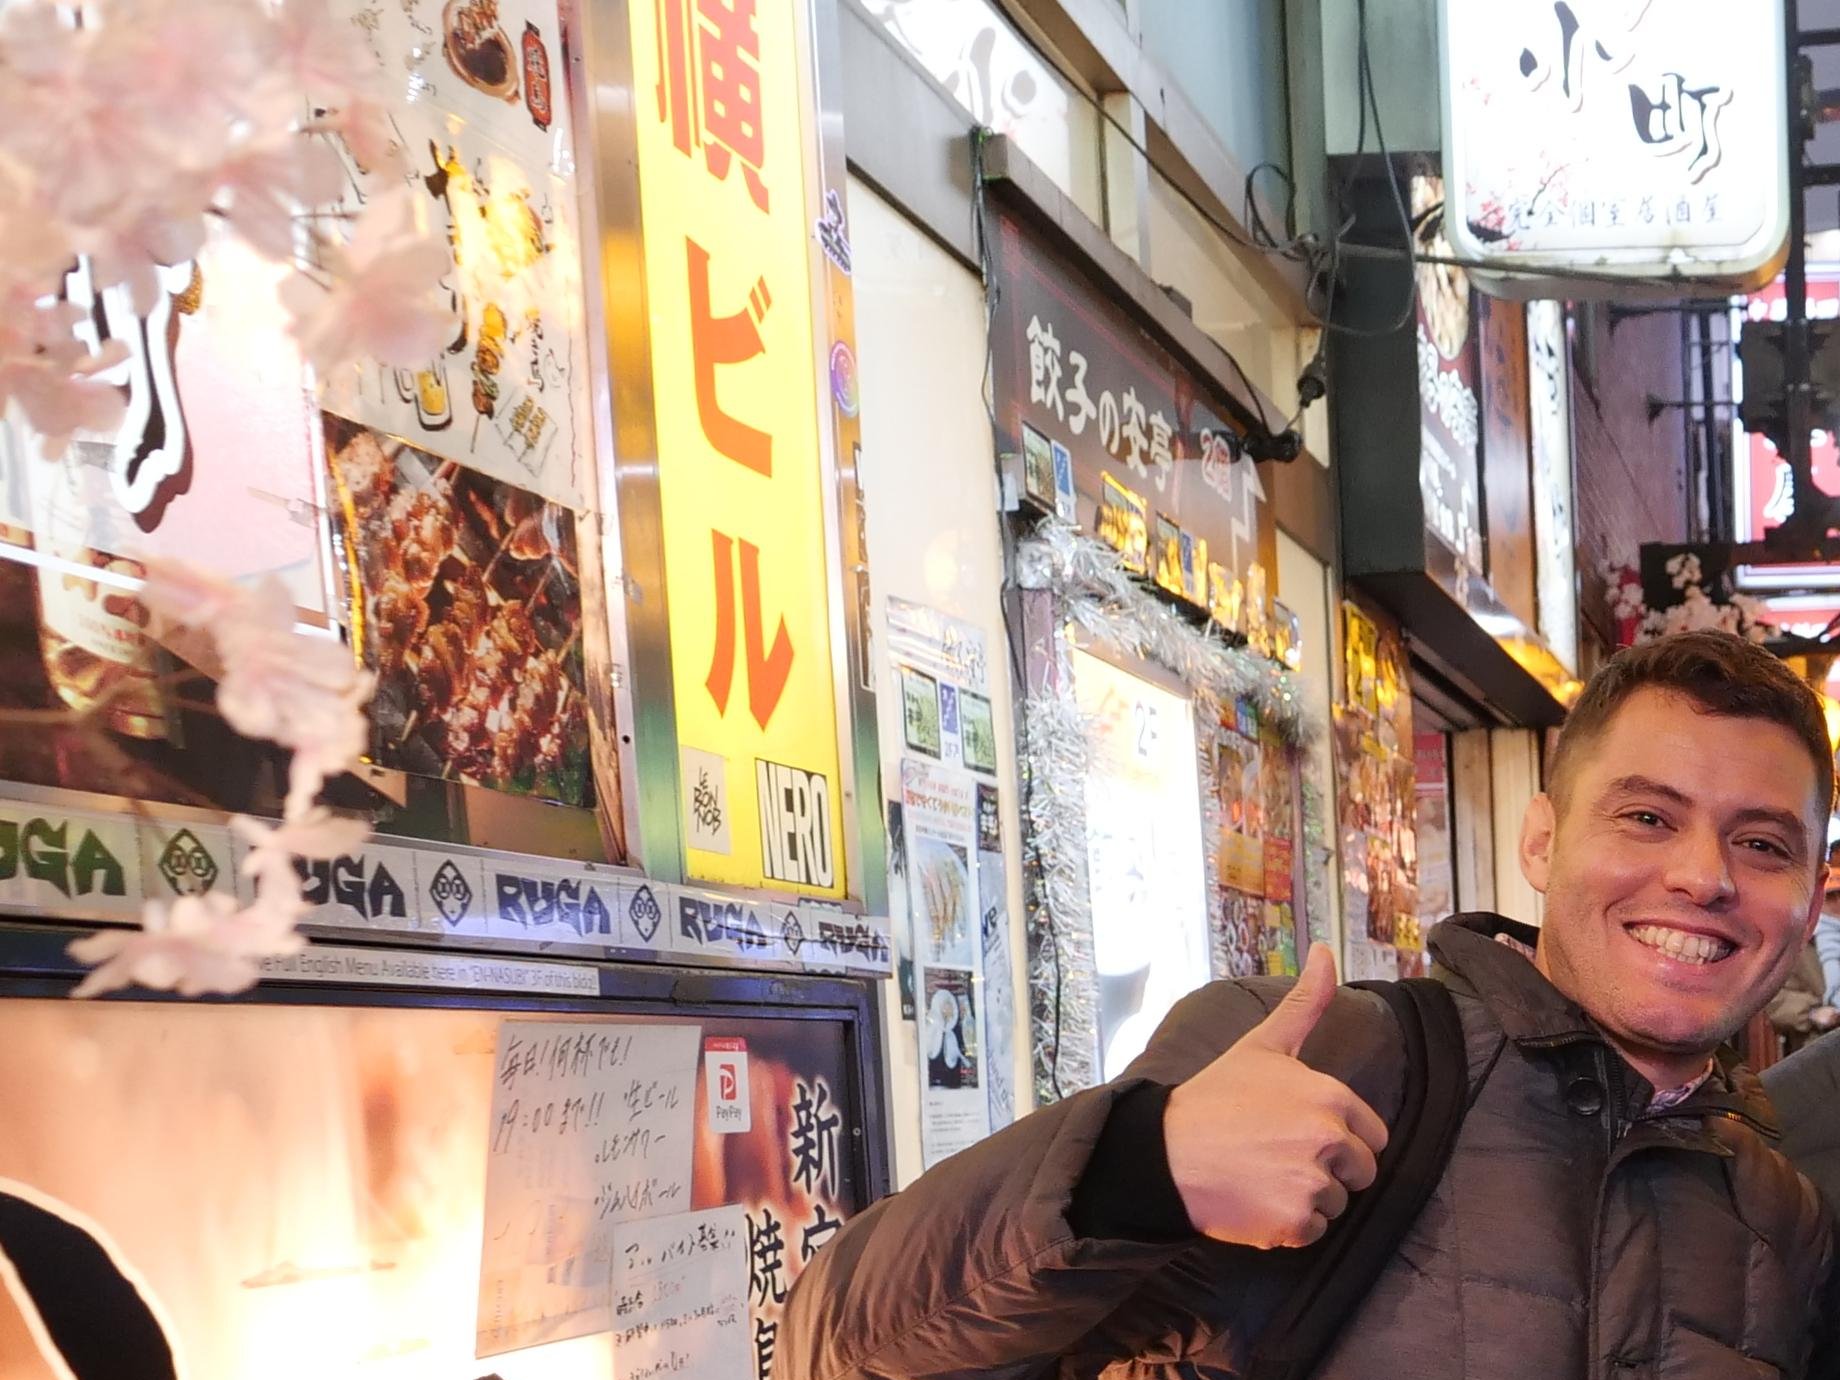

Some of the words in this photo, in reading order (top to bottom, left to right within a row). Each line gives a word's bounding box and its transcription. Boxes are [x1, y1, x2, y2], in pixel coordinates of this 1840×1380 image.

[1026, 315, 1172, 492] 餃子の安亭
[756, 759, 833, 888] NERO
[0, 817, 127, 899] GA
[495, 873, 611, 937] RUGA
[679, 896, 769, 948] RUGA
[300, 954, 341, 977] English
[345, 957, 378, 975] Menu
[382, 959, 431, 979] Available
[819, 919, 889, 963] RUGA
[715, 1105, 742, 1122] PayPay
